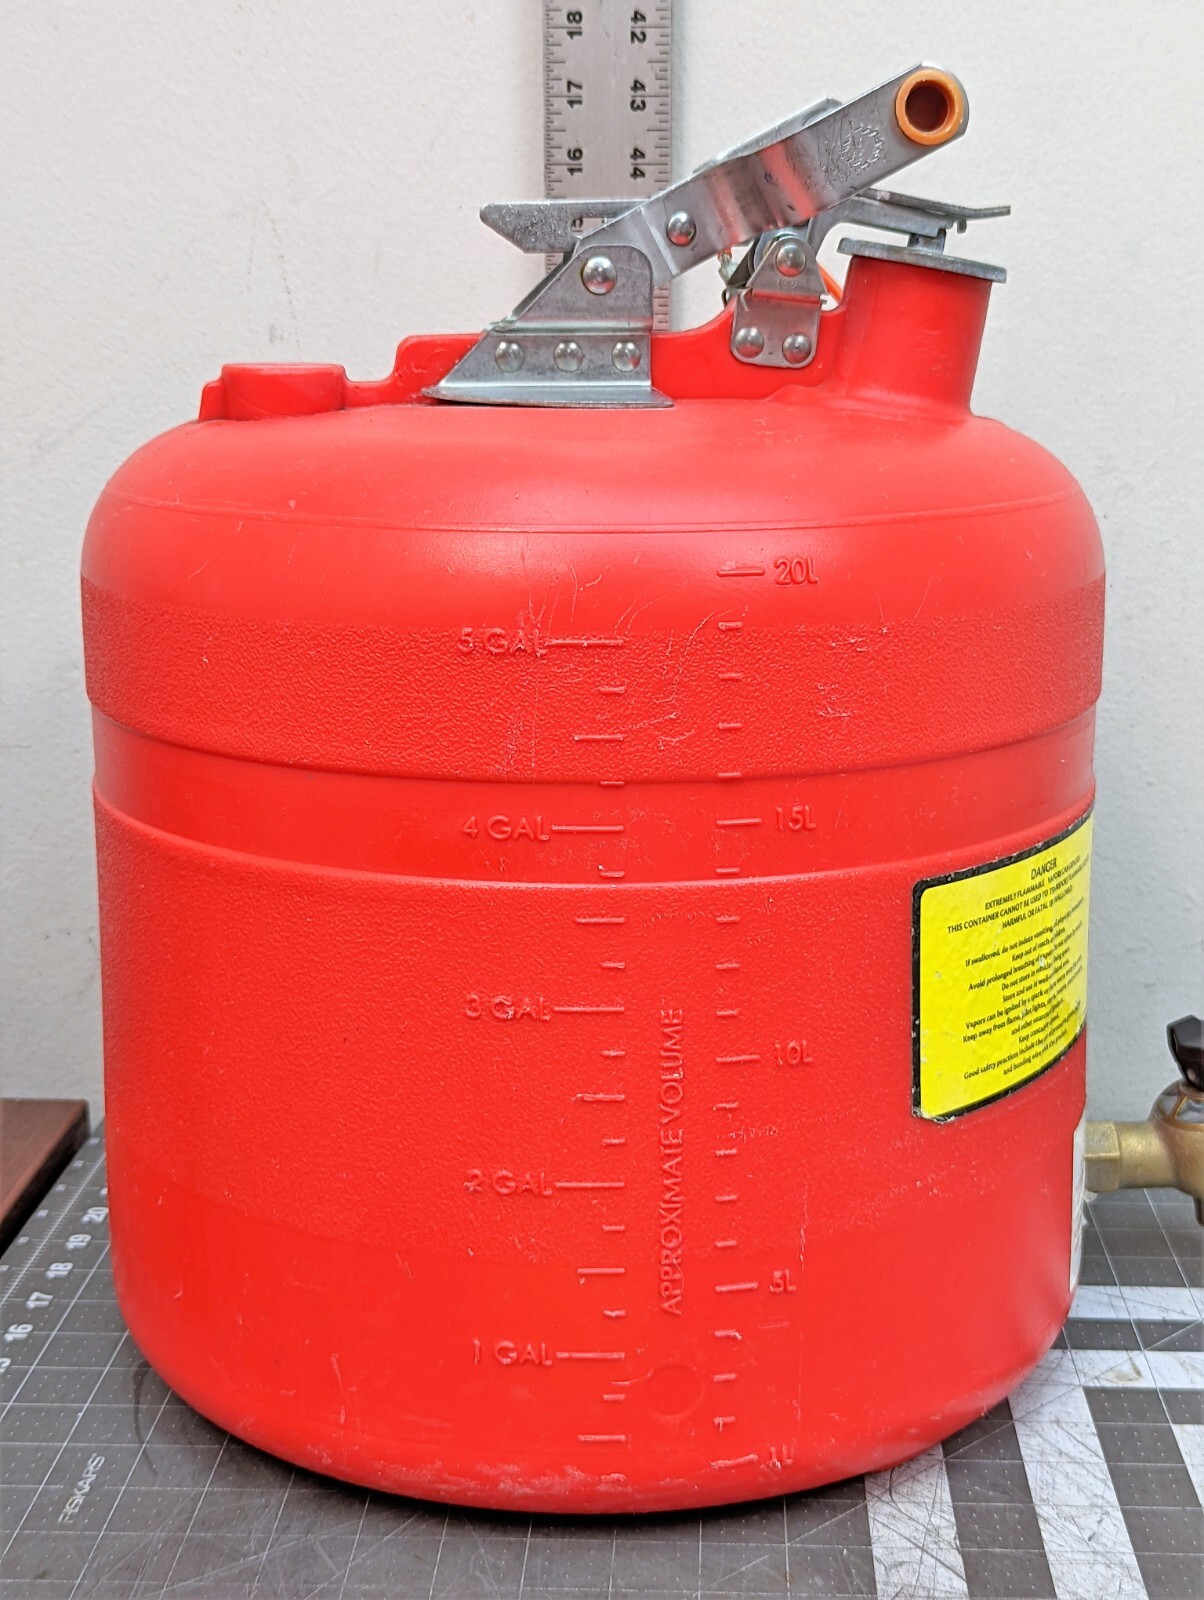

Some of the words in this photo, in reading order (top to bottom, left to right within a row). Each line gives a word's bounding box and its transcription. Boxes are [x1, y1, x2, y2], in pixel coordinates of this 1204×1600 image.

[567, 10, 583, 40] 18
[630, 10, 647, 44] 42
[567, 79, 583, 109] 17
[630, 79, 647, 112] 43
[567, 147, 583, 176] 16
[630, 147, 646, 180] 44
[773, 557, 818, 586] 20L
[457, 627, 474, 653] 5
[483, 627, 548, 657] GAL
[462, 815, 478, 838] 4
[486, 815, 550, 841] GAL
[775, 805, 816, 832] 15L
[1030, 857, 1056, 880] DANGER
[985, 892, 1016, 910] EXTREMELY
[1017, 879, 1044, 898] FLAMMABLE
[947, 923, 962, 934] THIS
[963, 911, 998, 929] CONTAINER
[999, 901, 1022, 917] CANNOT
[1030, 892, 1041, 904] USED
[1002, 912, 1026, 929] HARMFUL
[1027, 908, 1034, 918] OR
[971, 948, 1000, 965] swallowed,
[1001, 946, 1008, 954] do
[1009, 942, 1017, 951] not
[1012, 951, 1023, 962] Keep
[968, 978, 985, 991] Avoid
[986, 968, 1012, 986] prolonged
[1001, 981, 1008, 990] Do
[1018, 972, 1029, 983] store
[1002, 991, 1015, 1002] Store
[1016, 986, 1024, 996] and
[464, 993, 482, 1019] 3
[490, 994, 551, 1021] GAL
[965, 1016, 985, 1030] Vapors
[986, 1012, 995, 1022] can
[997, 1009, 1002, 1017] be
[963, 1031, 977, 1044] Keep
[978, 1027, 991, 1038] away
[1018, 1032, 1029, 1044] Keep
[774, 1040, 813, 1064] 10L
[658, 1007, 684, 1125] VOLUME
[964, 1067, 979, 1079] Good
[465, 1168, 483, 1192] 2
[492, 1169, 553, 1196] GAL
[82, 1207, 109, 1223] 20
[658, 1128, 683, 1315] APPROXIMATE
[66, 1234, 92, 1249] 19
[46, 1262, 73, 1279] 18
[769, 1269, 796, 1293] 5L
[26, 1292, 53, 1309] 17
[4, 1324, 33, 1342] 16
[472, 1338, 481, 1364] 1
[494, 1340, 553, 1367] GAL
